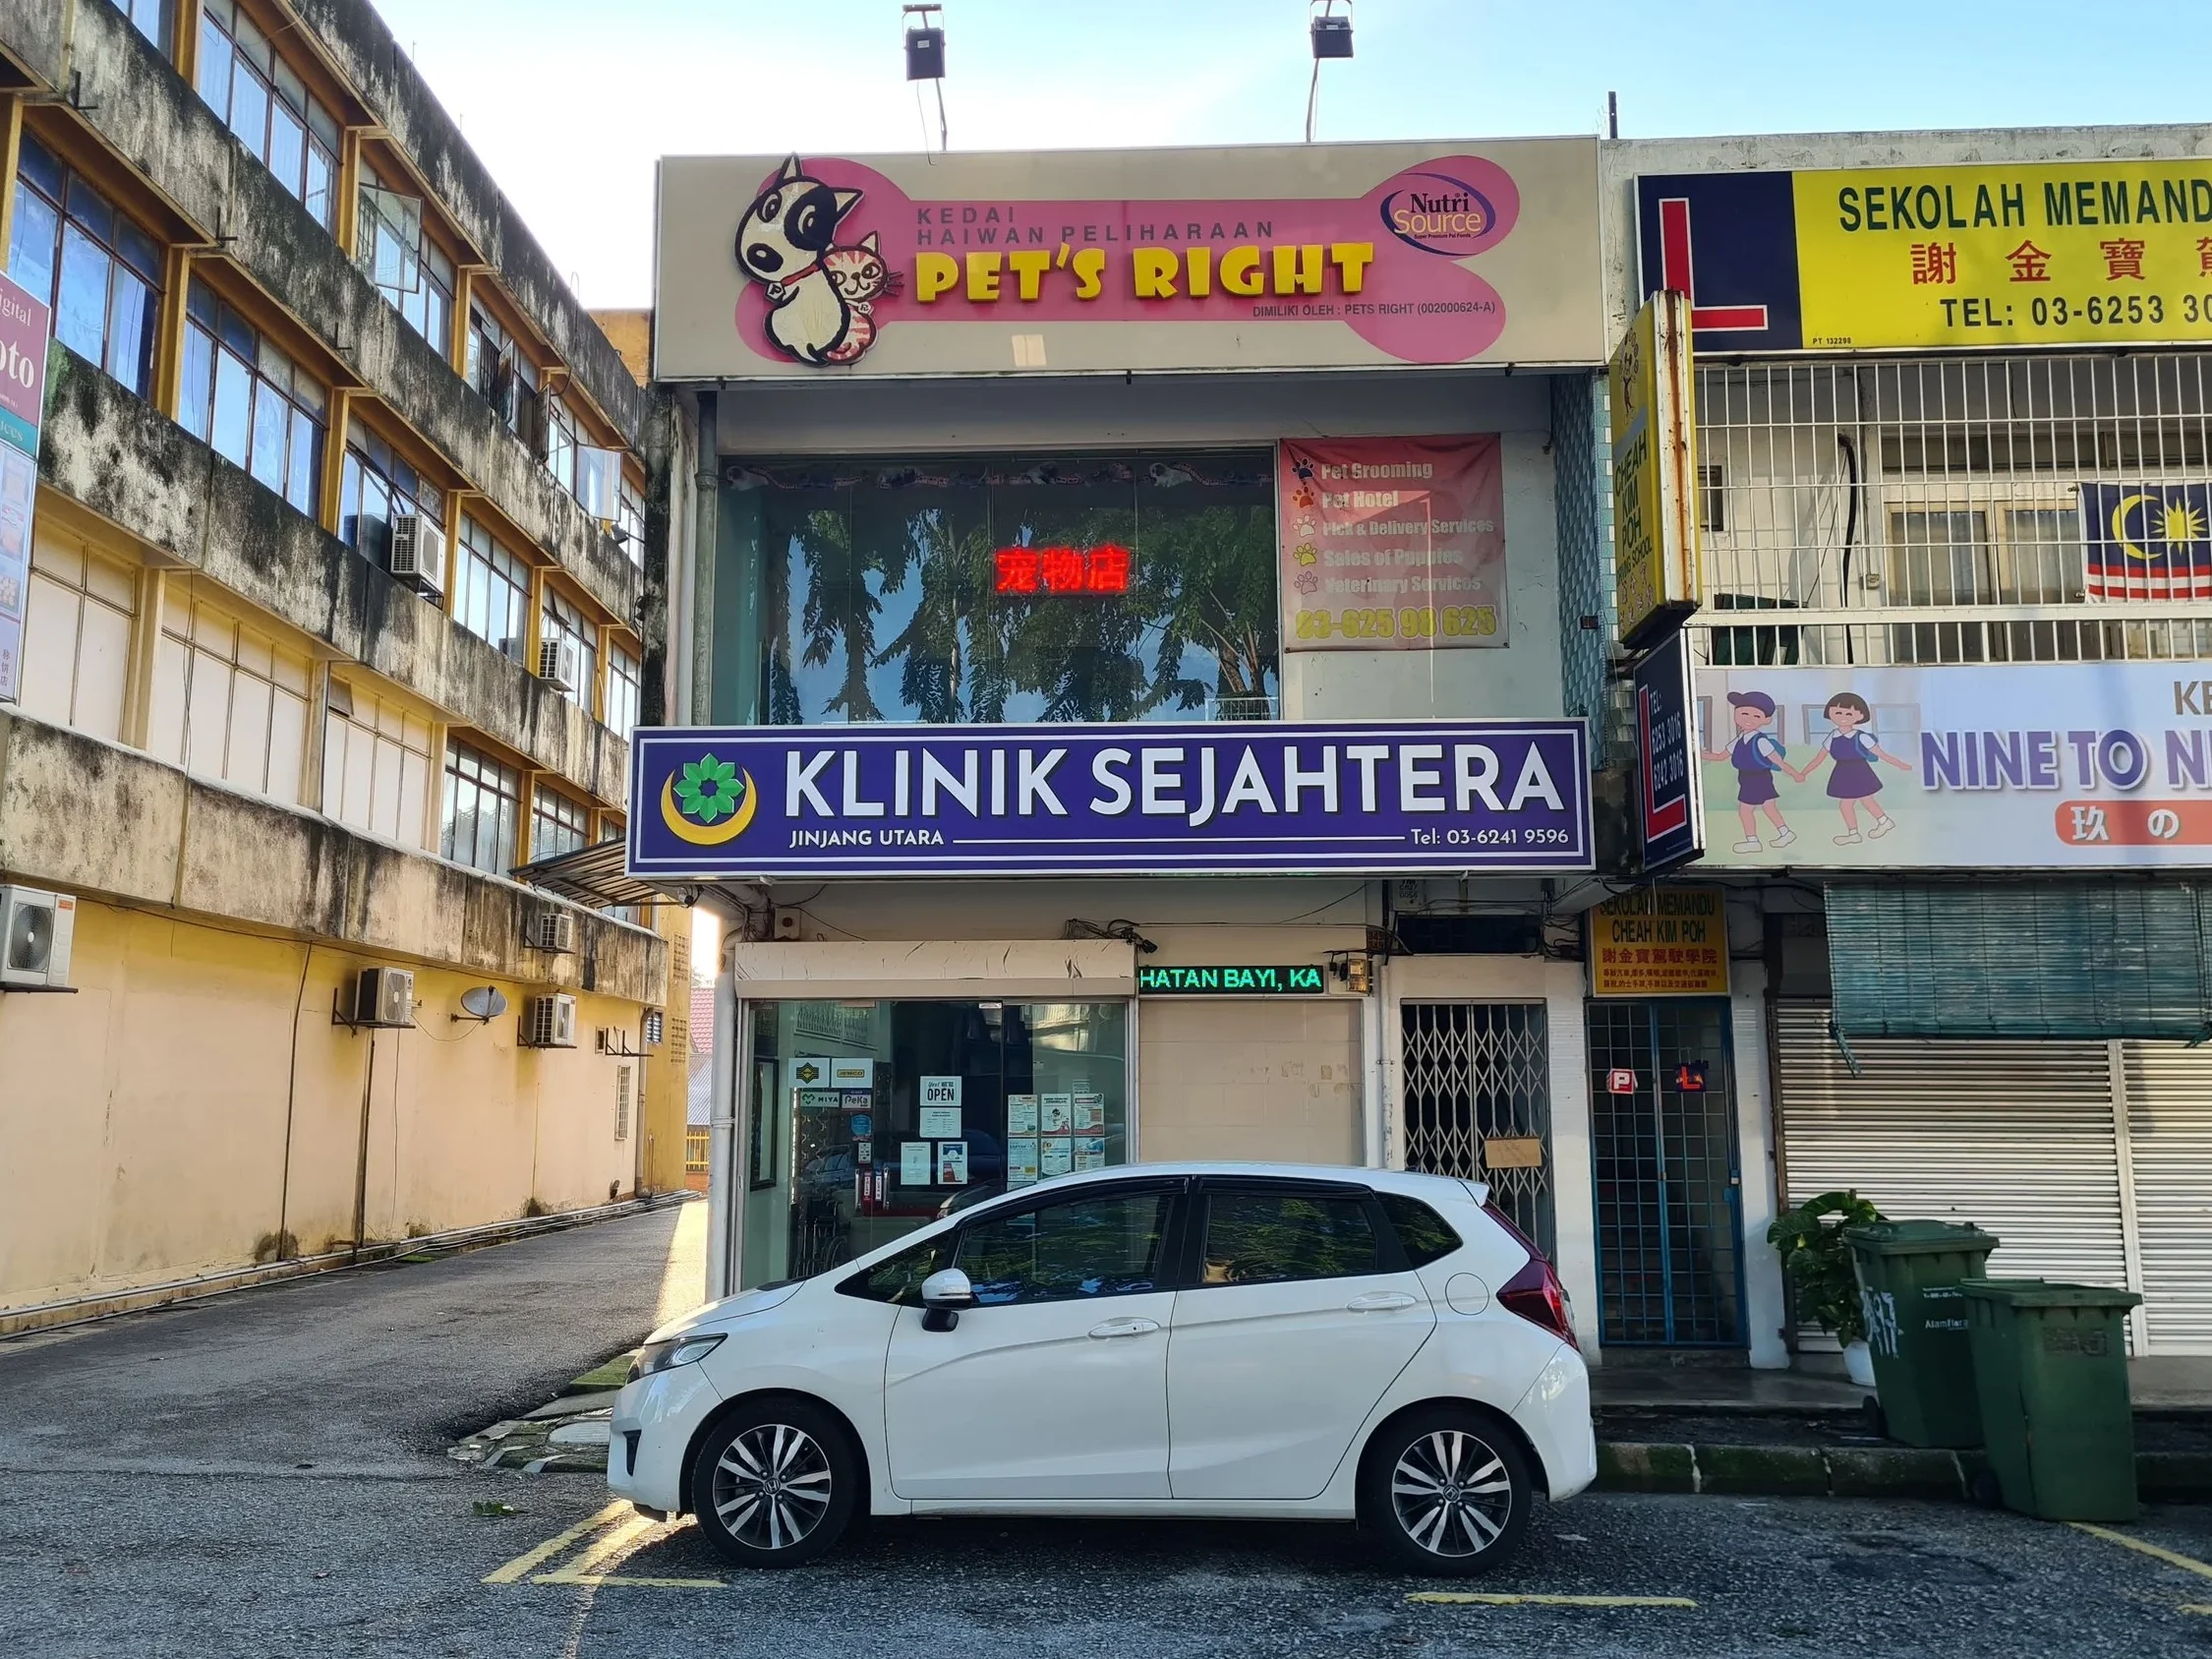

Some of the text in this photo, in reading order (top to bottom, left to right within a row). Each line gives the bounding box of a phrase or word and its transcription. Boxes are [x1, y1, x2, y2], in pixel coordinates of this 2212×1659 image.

[1410, 192, 1470, 213] Nutri
[1838, 178, 2212, 232] SEKOLAH MEMAND
[917, 207, 1014, 224] KEDAI
[1393, 208, 1482, 234] Source
[917, 221, 1272, 245] HAIWAN PELIHARAAN
[915, 242, 1374, 303] PET'S RIGHT
[1252, 305, 1299, 318] DIMILIKI
[1303, 304, 1334, 316] OLEH
[1344, 303, 1375, 315] PETS
[1378, 303, 1415, 315] RIGHT
[1417, 301, 1496, 315] (002000624-A)
[1940, 298, 2014, 327] TEL:
[2032, 295, 2165, 326] 03-6253
[1320, 461, 1433, 480] Pet Grooming
[1614, 428, 1648, 498] CHEAH
[1321, 490, 1399, 508] Pet Hotel
[1621, 474, 1639, 520] KIM
[1369, 519, 1428, 537] Delivery
[1430, 518, 1494, 534] Services
[1621, 506, 1642, 558] POH
[1323, 548, 1464, 567] Sales of Puppies
[1631, 532, 1653, 568] SCHOOL
[996, 544, 1130, 594] 宠物店
[1324, 575, 1483, 594] Veterinary Services
[1398, 606, 1438, 639] 98
[1441, 605, 1497, 637] 625
[1650, 689, 1662, 716] TEL:
[1921, 728, 2212, 791] NINE TO N
[786, 741, 1565, 827] KLINIK SEJAHTERA
[788, 829, 945, 850] JINJANG UTARA
[1411, 828, 1569, 846] Tel: 03-6241 9596
[1657, 892, 1716, 916] MEMANDU
[1611, 919, 1707, 943] CHEAH KIM POH
[1139, 969, 1322, 991] HATAN BAYI, KA
[844, 1095, 868, 1104] PeKa
[927, 1088, 955, 1101] OPEN
